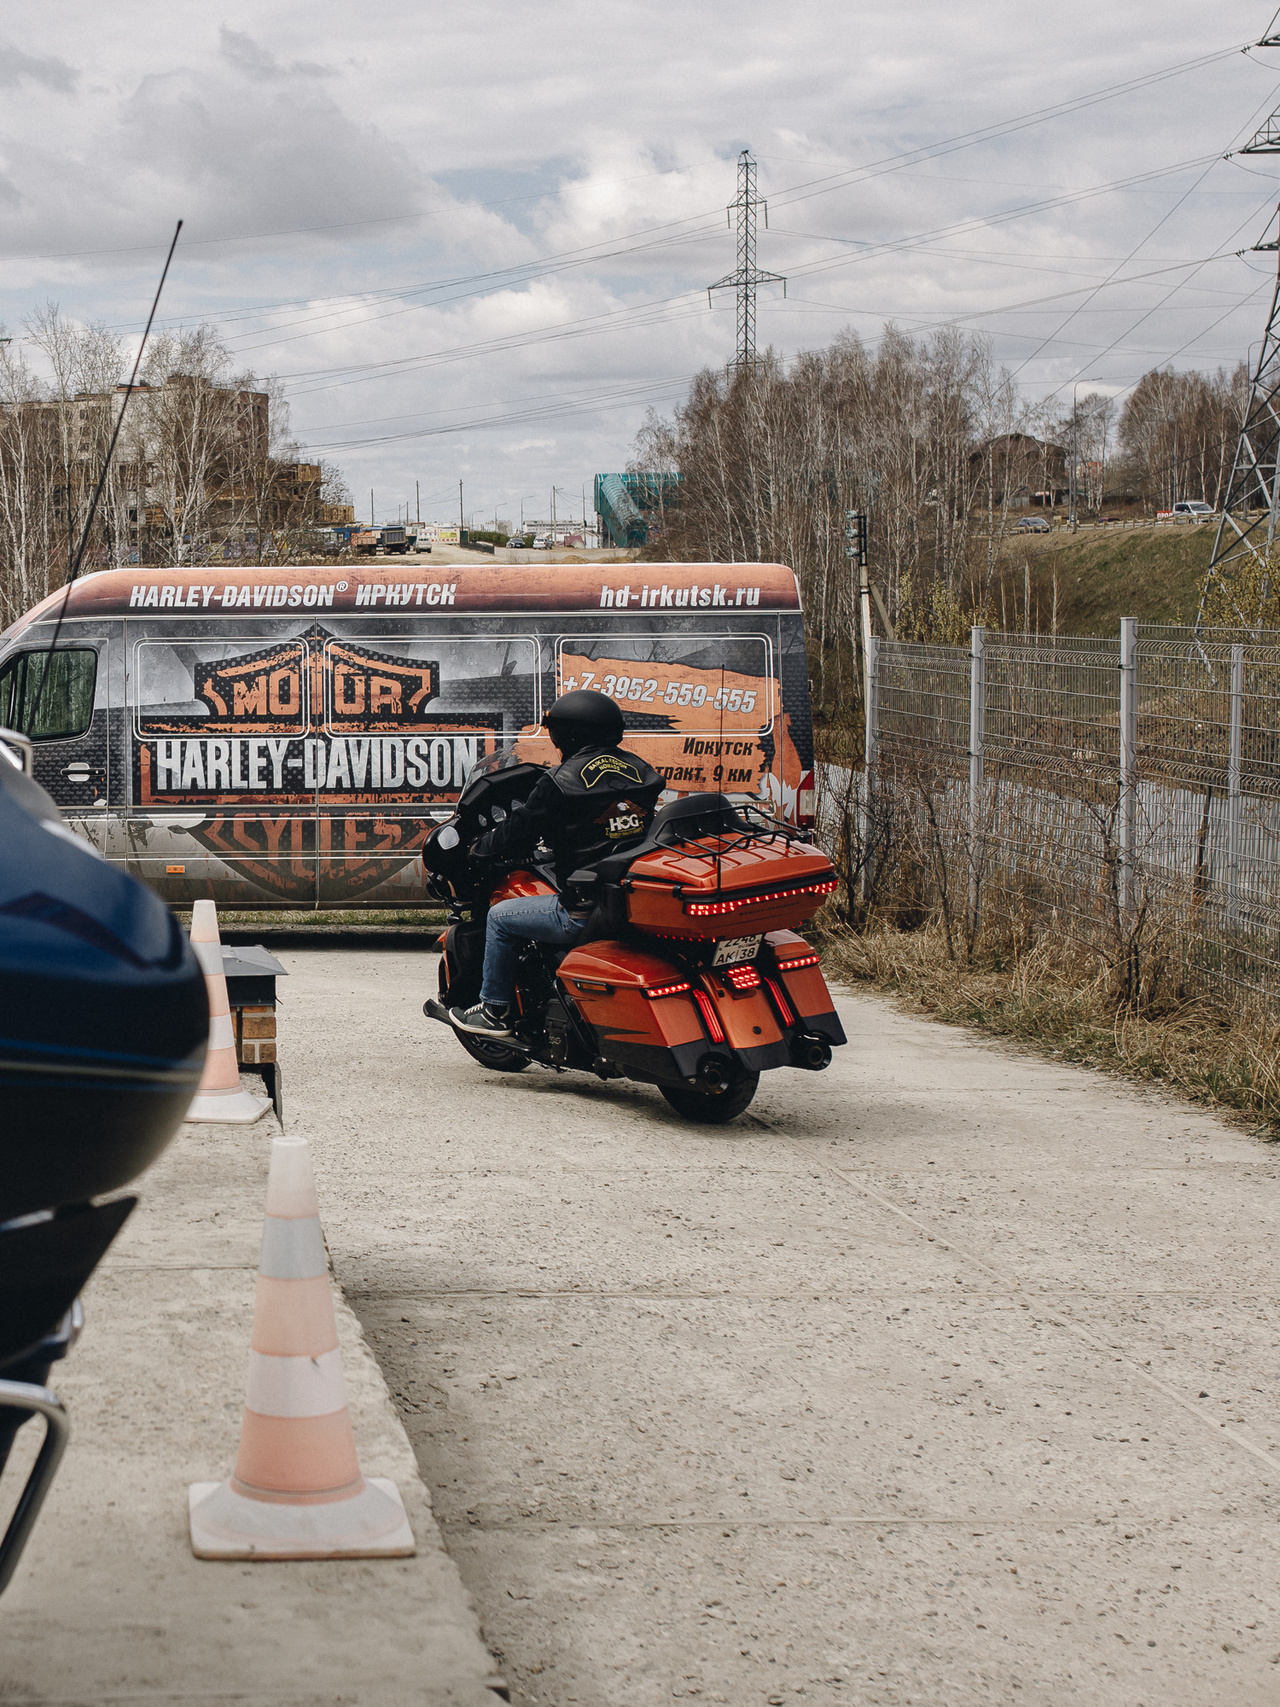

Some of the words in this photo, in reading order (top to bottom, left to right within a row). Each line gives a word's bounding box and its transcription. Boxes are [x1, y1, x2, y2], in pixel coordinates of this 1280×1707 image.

[355, 583, 457, 606] ИРКУТСК
[599, 584, 761, 608] hd-irkutsk.ru
[233, 650, 403, 716] MOTOR
[562, 671, 758, 714] +7-3952-559-555
[682, 736, 754, 757] Иркутск
[156, 737, 478, 790] HARLEY-DAVIDSON
[713, 764, 724, 782] 9
[727, 768, 753, 783] км
[609, 813, 640, 832] HOG
[233, 811, 403, 881] CYCLES
[739, 947, 756, 959] 38
